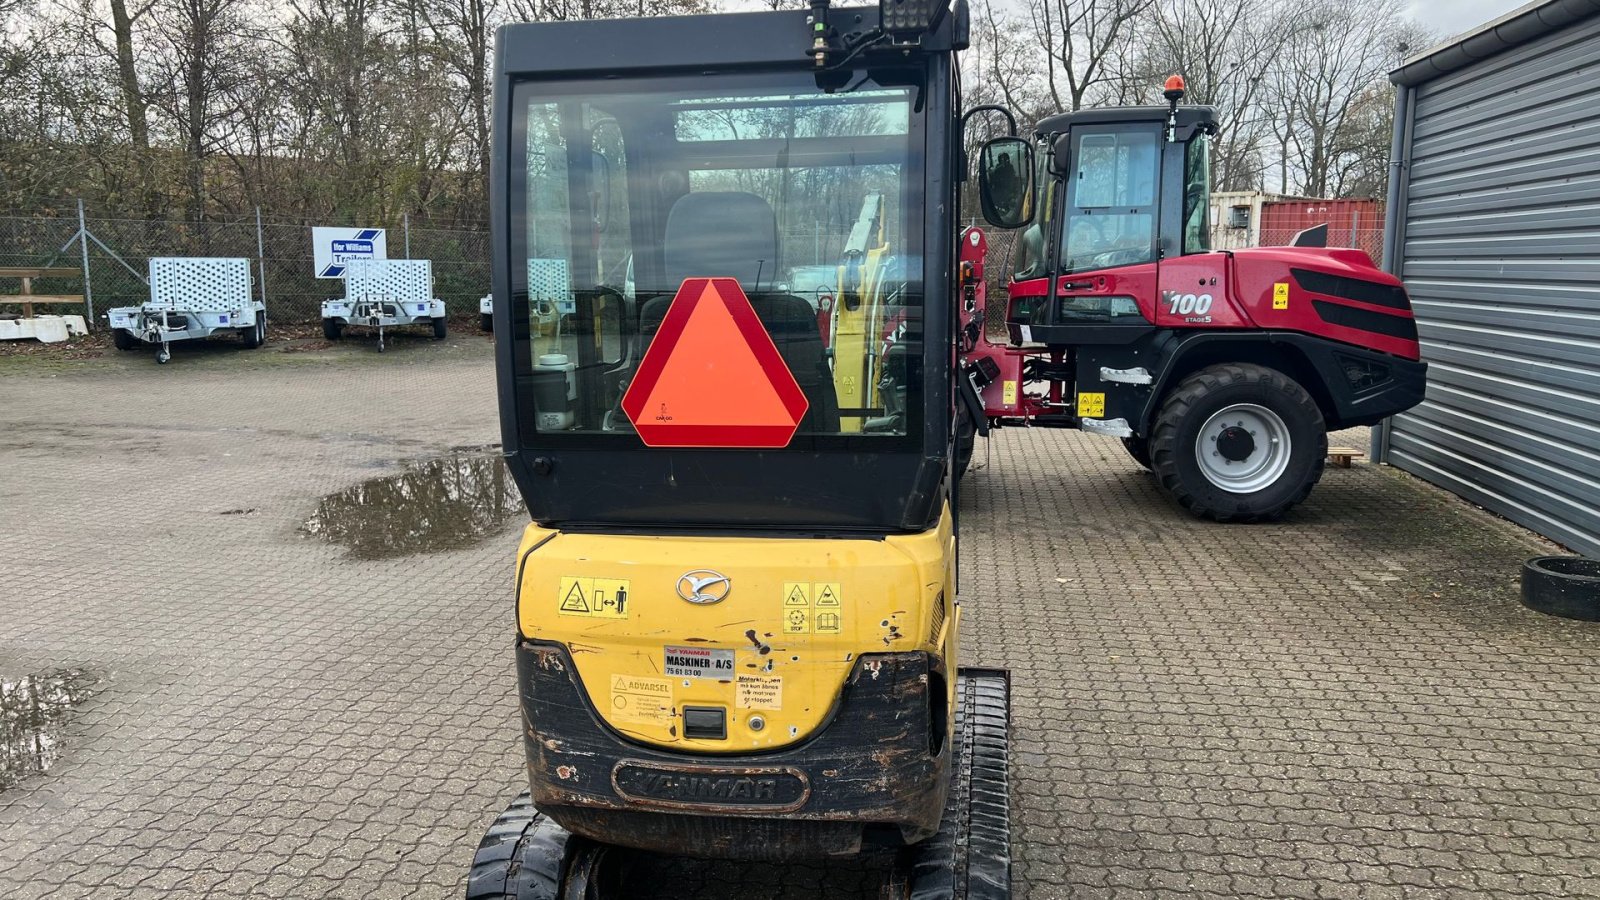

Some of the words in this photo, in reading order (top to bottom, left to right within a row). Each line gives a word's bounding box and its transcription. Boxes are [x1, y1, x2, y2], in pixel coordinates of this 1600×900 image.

[345, 243, 372, 252] Williams
[1162, 290, 1213, 315] V100
[666, 655, 711, 668] MASKINER
[715, 659, 732, 669] A/S
[666, 667, 674, 675] 75
[675, 668, 683, 676] 61
[693, 669, 702, 677] 00
[628, 681, 670, 693] ADVARSEL
[635, 772, 777, 800] YANMAR
